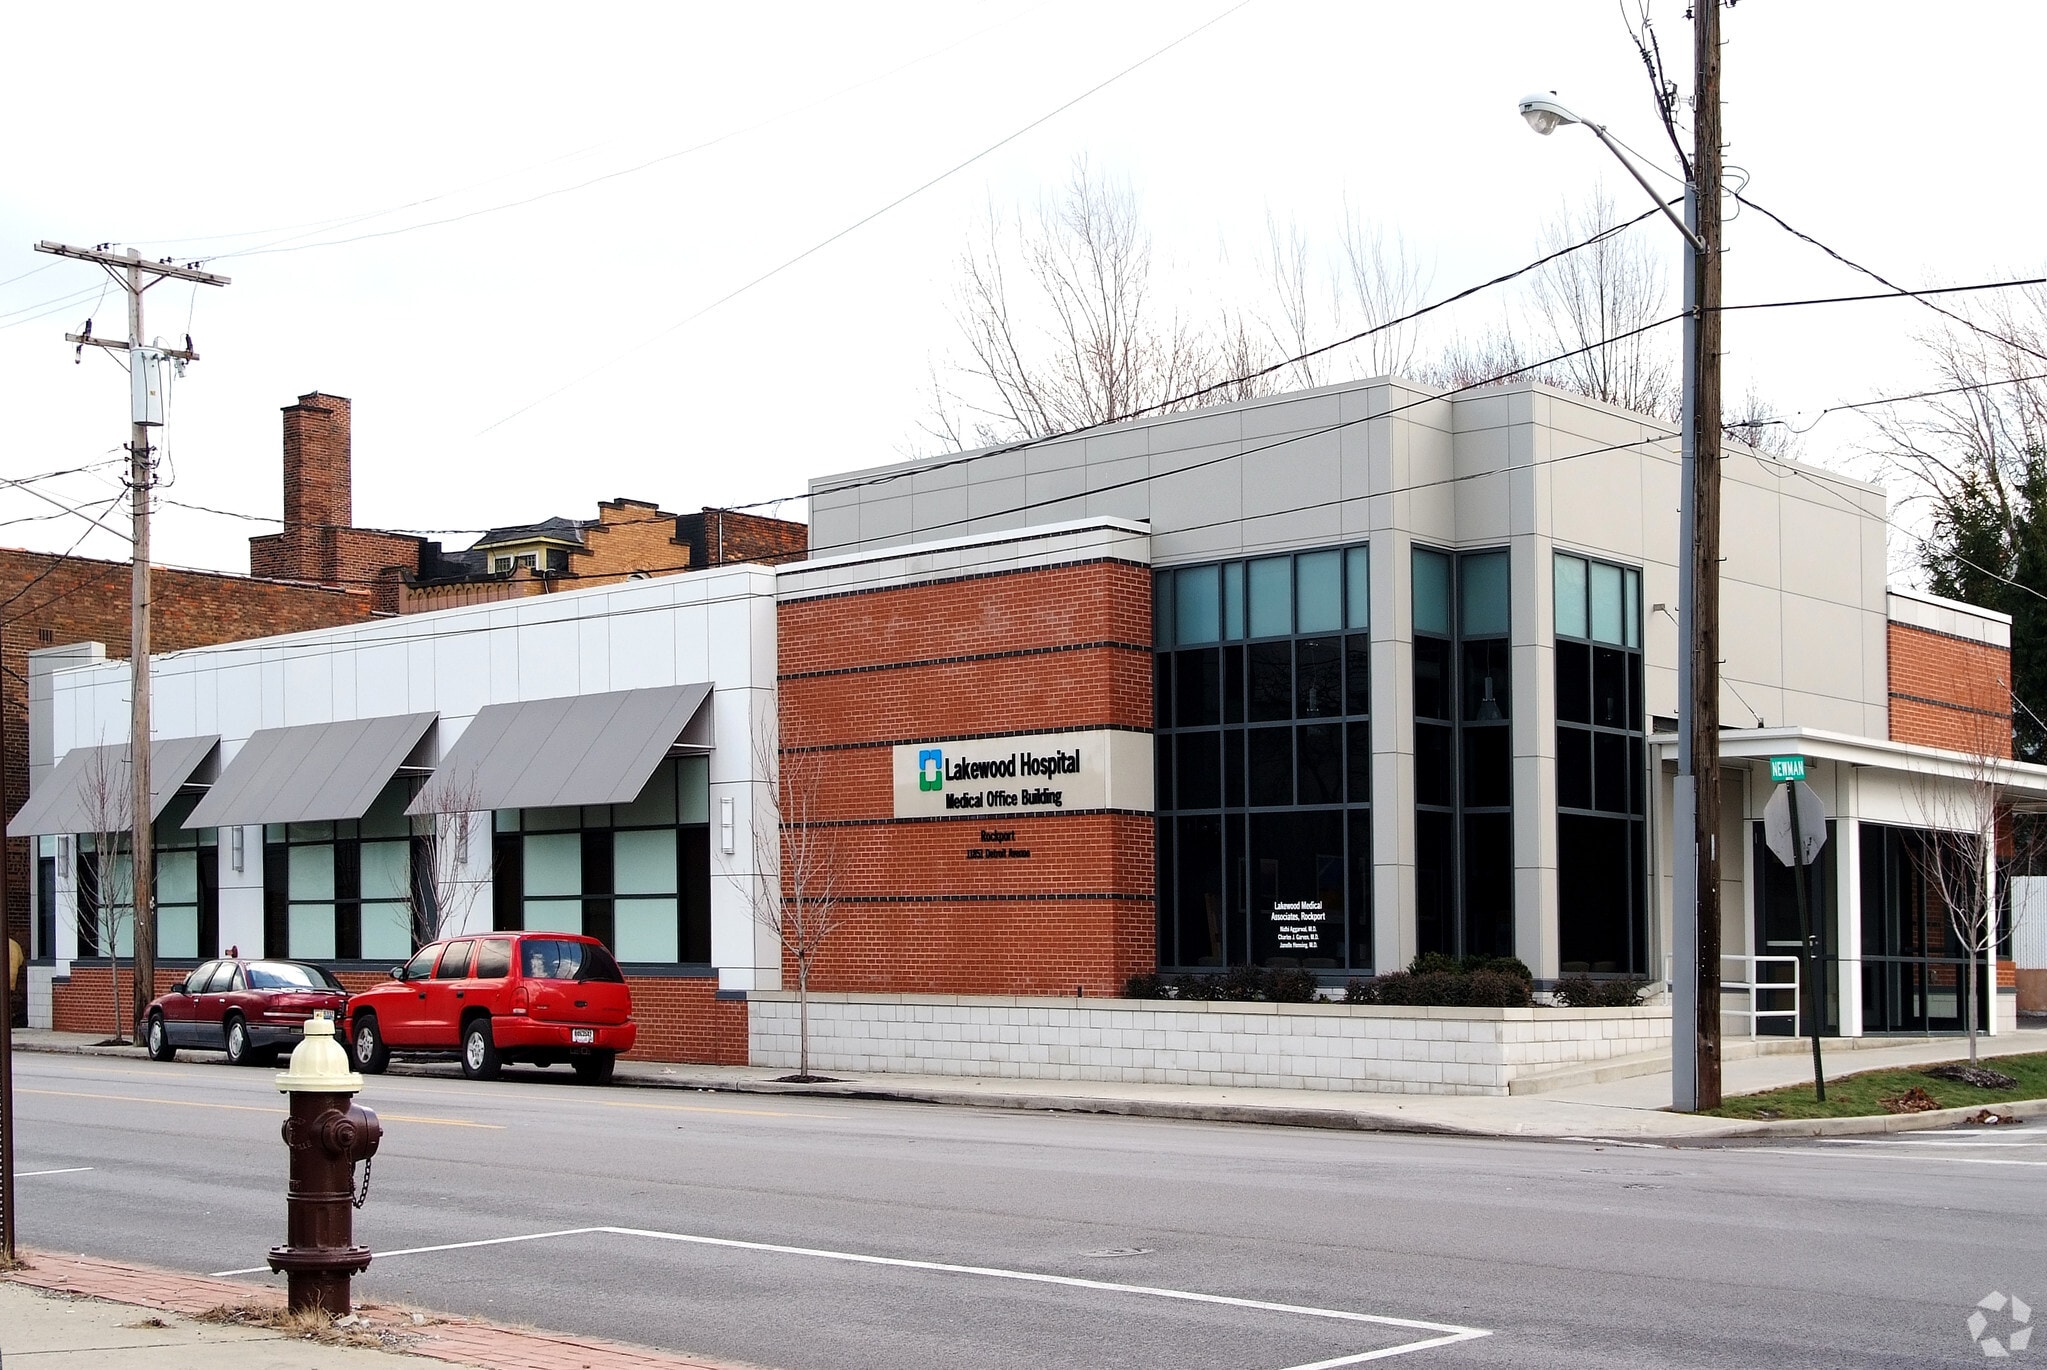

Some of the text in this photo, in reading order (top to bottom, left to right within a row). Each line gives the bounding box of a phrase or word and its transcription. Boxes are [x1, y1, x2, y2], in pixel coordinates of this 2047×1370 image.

[945, 749, 1080, 781] Lakewood Hospital
[1772, 761, 1804, 776] NEWMAN
[945, 788, 1063, 809] Medical Office Building
[981, 830, 1016, 844] Rockport
[1274, 901, 1322, 910] Lakewood Medical
[1271, 912, 1326, 922] Associates, Rockport
